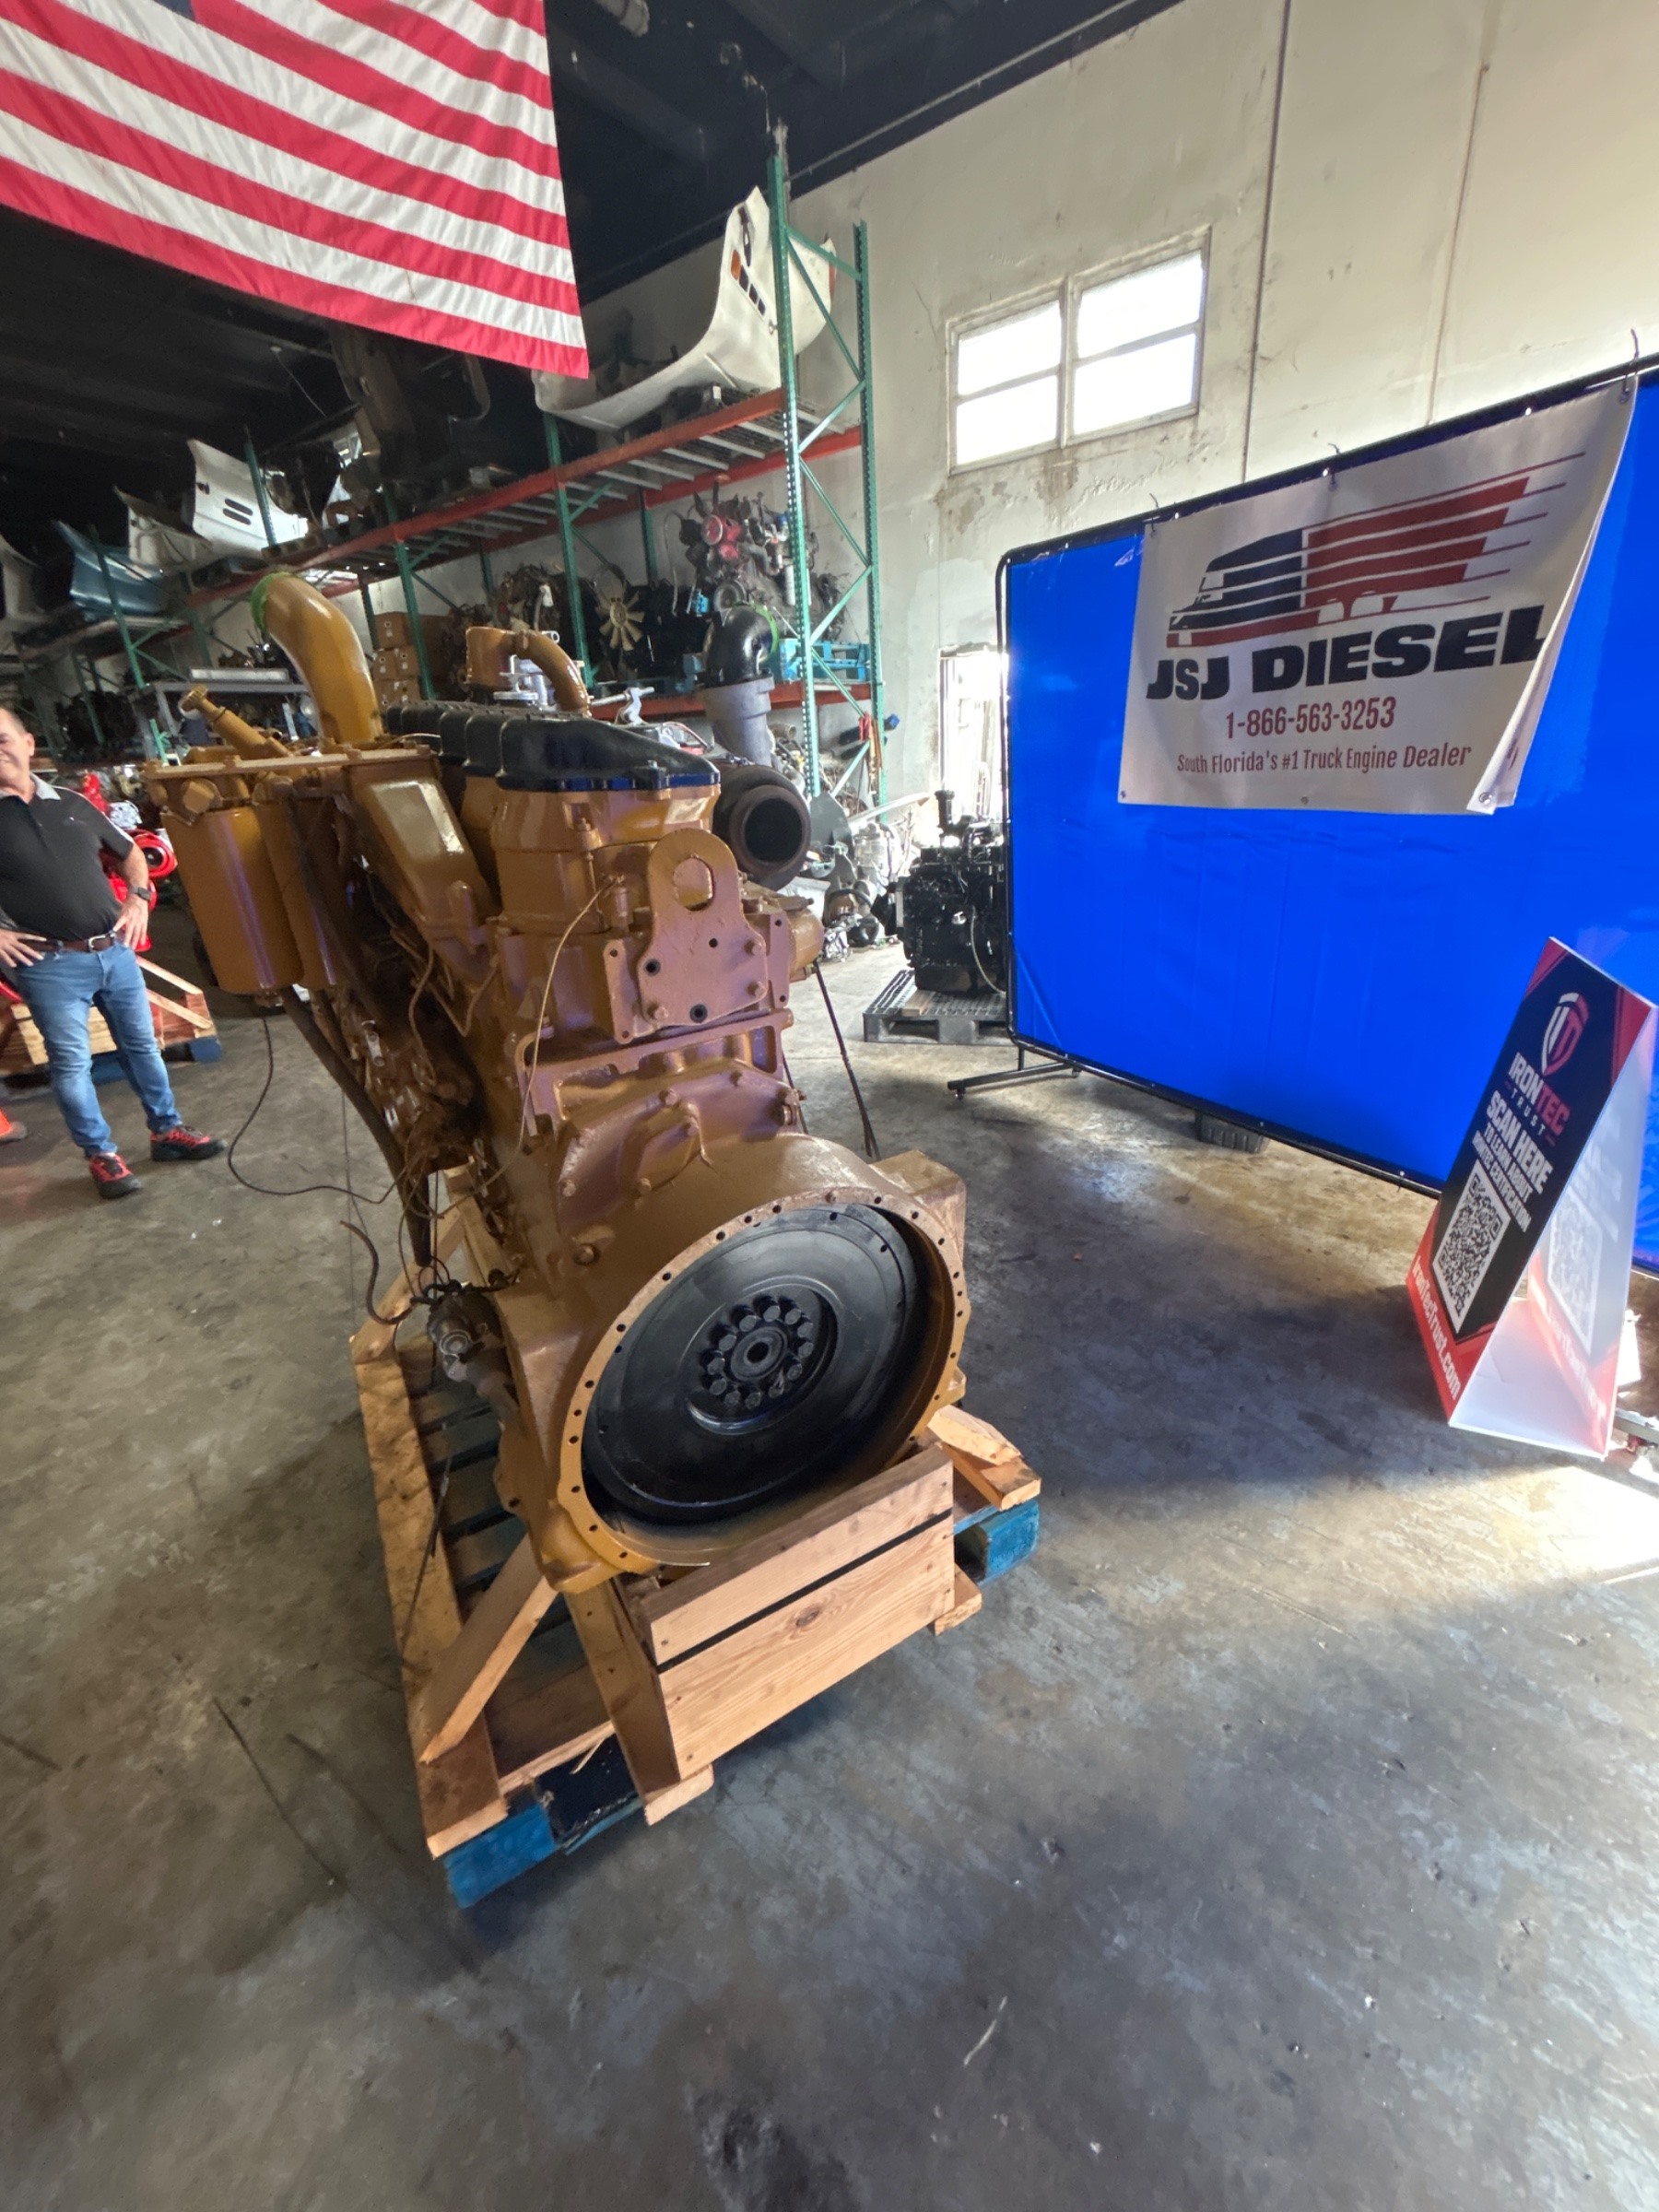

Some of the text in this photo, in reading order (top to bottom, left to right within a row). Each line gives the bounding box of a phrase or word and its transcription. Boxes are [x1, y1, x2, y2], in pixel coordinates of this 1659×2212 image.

[1147, 605, 1547, 700] JSJ DIESEL
[1226, 696, 1396, 739] 1-866-563-3253
[1177, 744, 1472, 773] South Florida's #1 Truck Engine Dealer
[1509, 1052, 1571, 1135] IRONTEC
[1512, 1088, 1546, 1135] TRUST
[1484, 1122, 1533, 1203] TO LEARN ABOUT
[1487, 1090, 1554, 1194] SCAN HERE
[1489, 1160, 1531, 1233] CERTIFICATION
